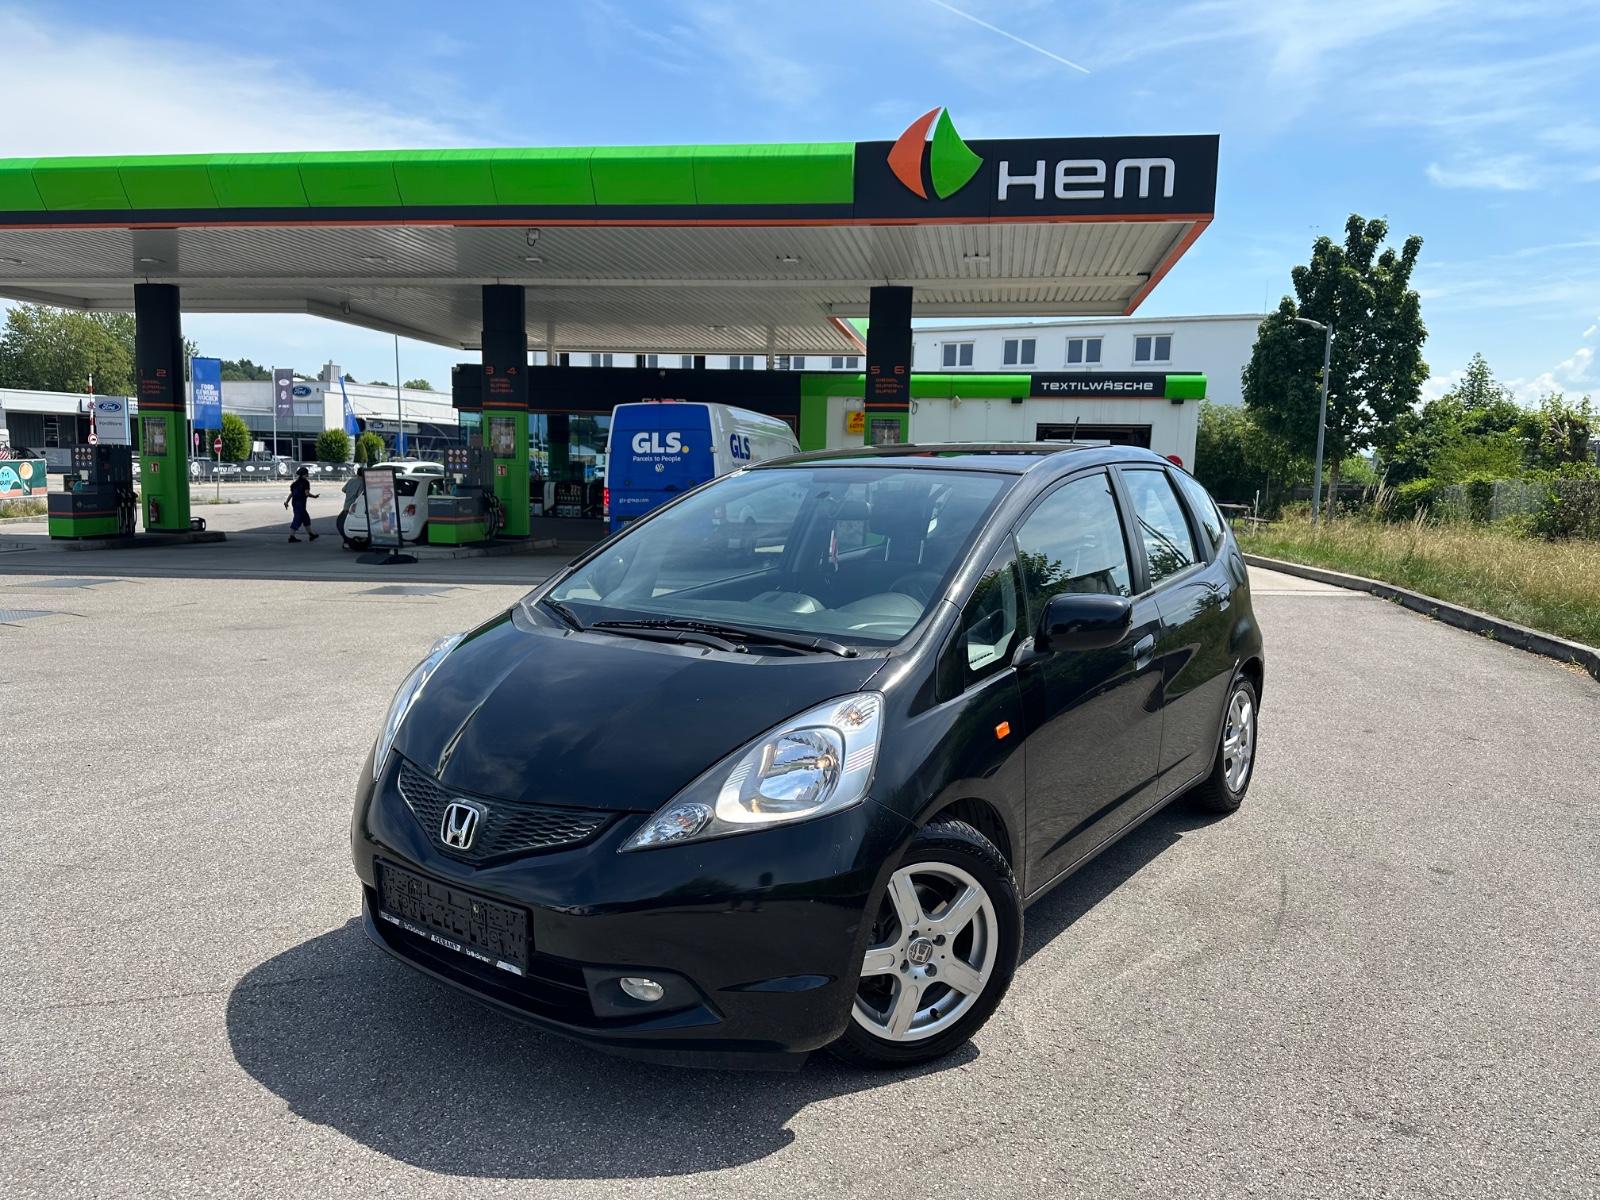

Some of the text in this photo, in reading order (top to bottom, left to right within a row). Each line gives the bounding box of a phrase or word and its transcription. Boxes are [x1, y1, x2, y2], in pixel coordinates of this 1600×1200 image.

[156, 368, 167, 377] 2
[485, 366, 518, 376] 3 4
[871, 365, 880, 375] 5
[101, 403, 119, 411] Ford
[661, 455, 681, 463] People
